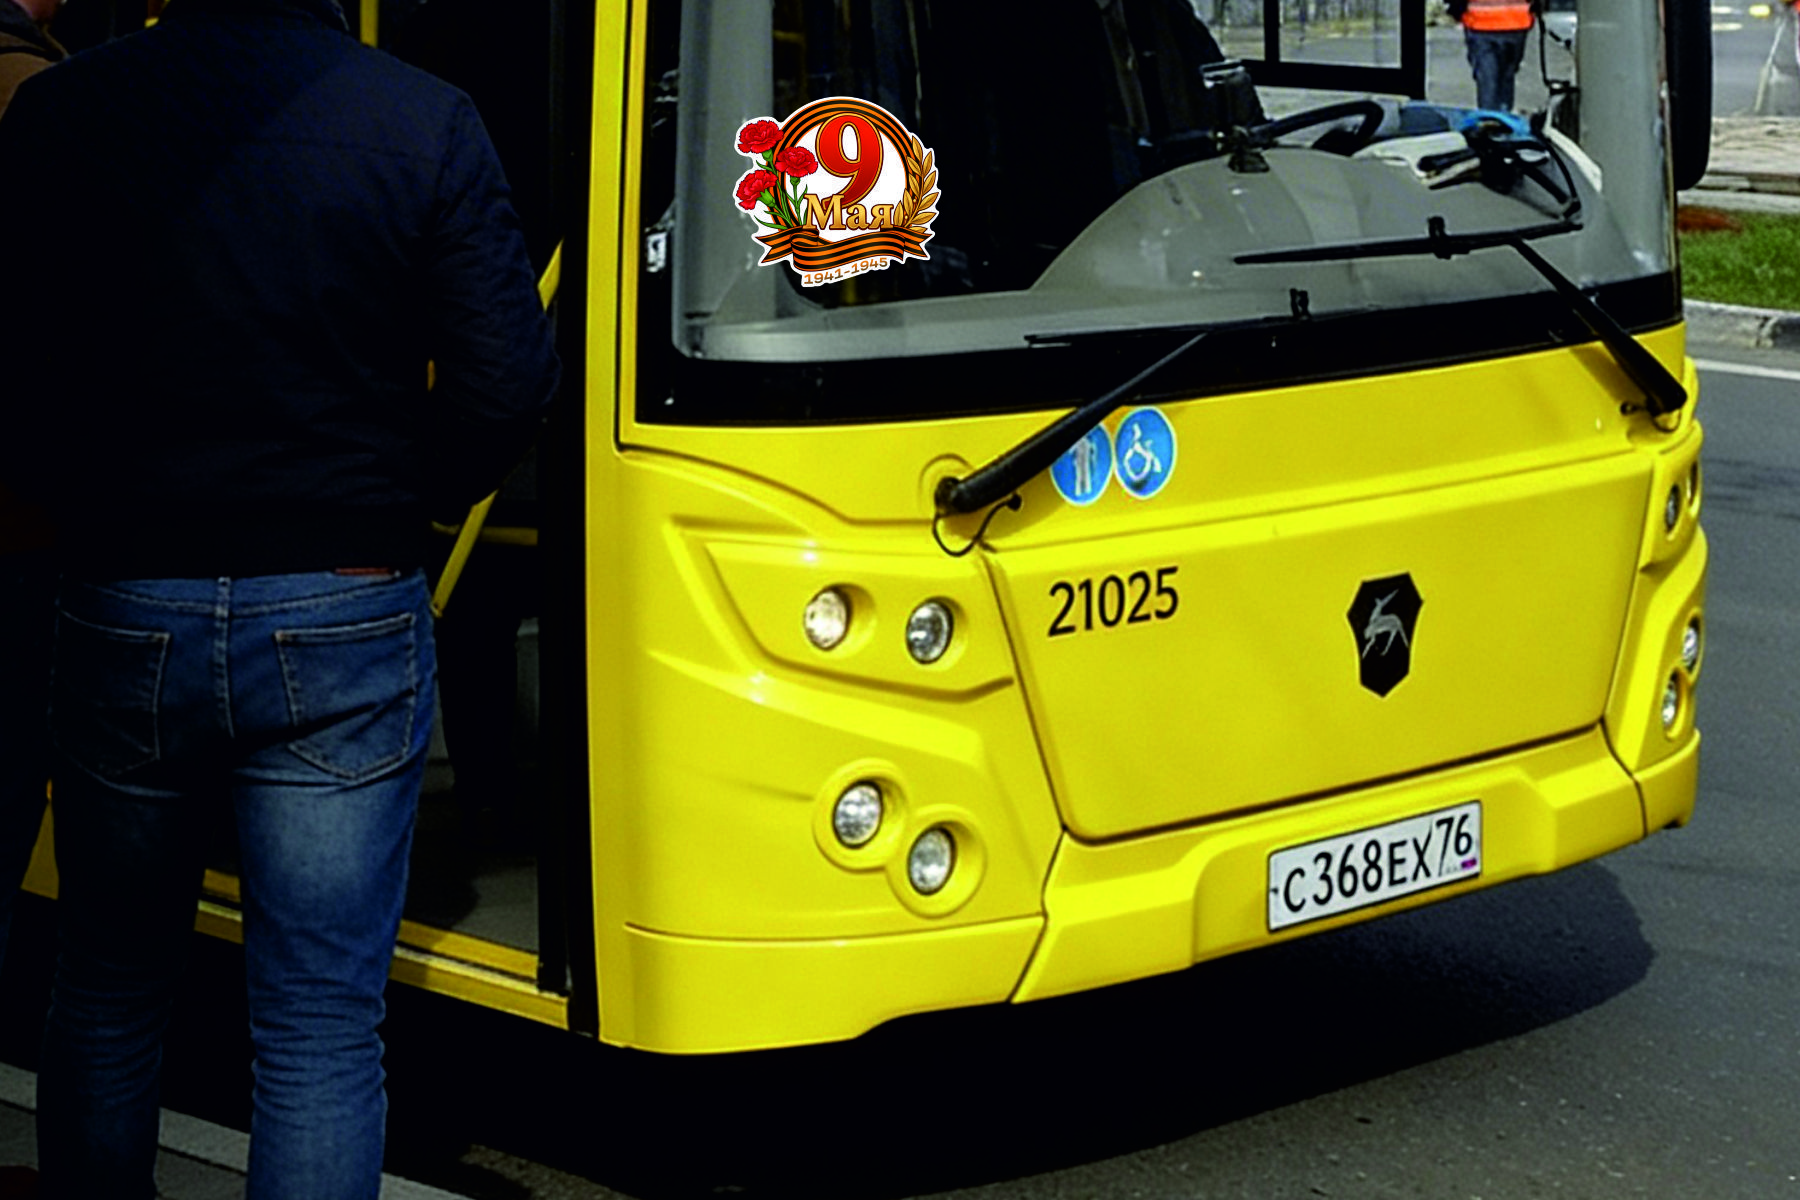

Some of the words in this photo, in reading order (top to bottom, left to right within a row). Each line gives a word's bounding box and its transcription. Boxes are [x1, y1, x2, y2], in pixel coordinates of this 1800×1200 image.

[815, 112, 884, 211] 9
[802, 193, 896, 230] Мая
[803, 257, 888, 285] 1941-1945
[1048, 566, 1179, 637] 21025
